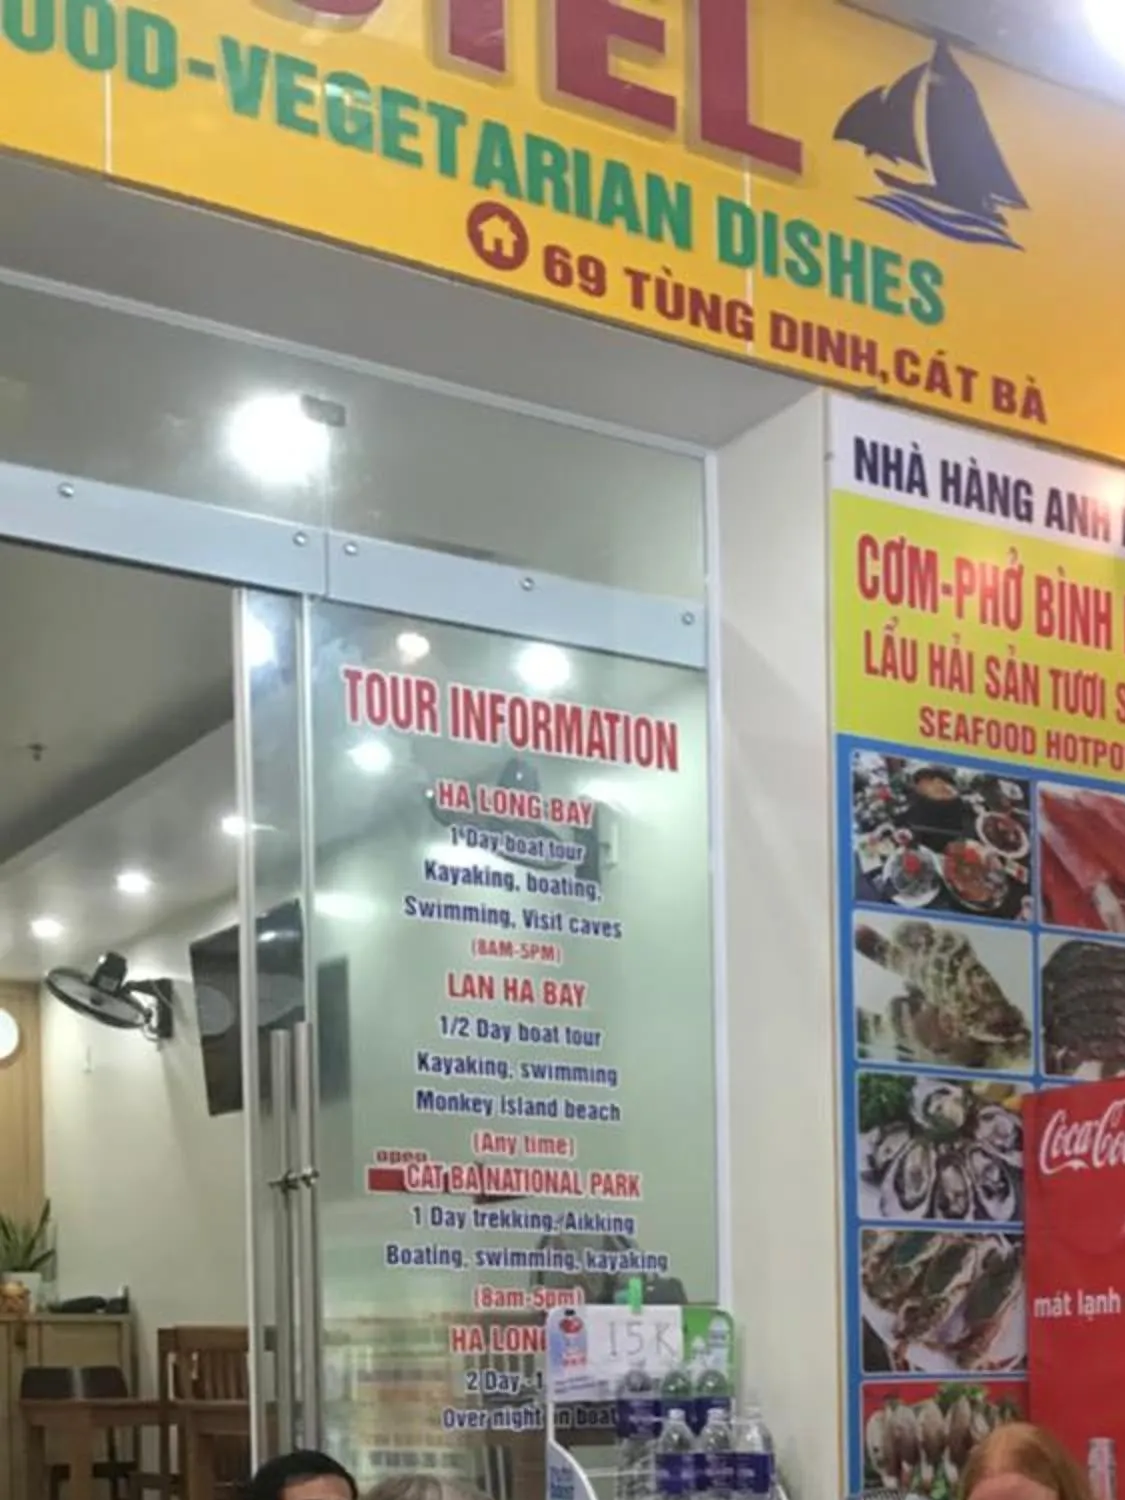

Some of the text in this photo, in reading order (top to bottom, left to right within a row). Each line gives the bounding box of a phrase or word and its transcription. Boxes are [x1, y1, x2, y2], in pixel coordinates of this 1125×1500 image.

[716, 194, 947, 327] DISHES
[543, 244, 608, 299] 69
[624, 266, 755, 344] TÙNG
[992, 374, 1048, 425] BÀ
[854, 437, 929, 498] NHÀ
[940, 456, 1034, 524] HÀNG
[1044, 487, 1112, 543] ANH
[1034, 565, 1112, 652] BÌNH
[928, 632, 975, 694] HẢI
[984, 644, 1040, 708] SẢN
[1048, 667, 1106, 721] TƯƠI
[343, 668, 679, 772] TOUR INFORMATION
[919, 704, 1037, 756] SEAFOOD
[438, 781, 593, 826] HA LONG BAY
[466, 826, 500, 852] Day
[505, 834, 546, 858] boat
[548, 840, 584, 862] tour
[522, 909, 564, 933] Visit
[569, 917, 624, 940] caves
[448, 971, 587, 1008] LAN HA BAY
[440, 1014, 603, 1047] 1/2 Day boat tour
[520, 1062, 618, 1087] swimming
[415, 1089, 494, 1116] Monkey
[564, 1098, 621, 1122] beach
[406, 1163, 642, 1198] CAT BA NATIONAL PARK
[412, 1205, 422, 1226] 1
[430, 1206, 466, 1229] Day
[585, 1250, 669, 1272] kayaking
[1034, 1289, 1073, 1318] mát
[1077, 1285, 1122, 1322] lạnh
[452, 1326, 482, 1351] HA
[466, 1371, 479, 1391] 2
[485, 1370, 520, 1393] Day
[443, 1408, 486, 1430] Over
[492, 1405, 542, 1430] night
